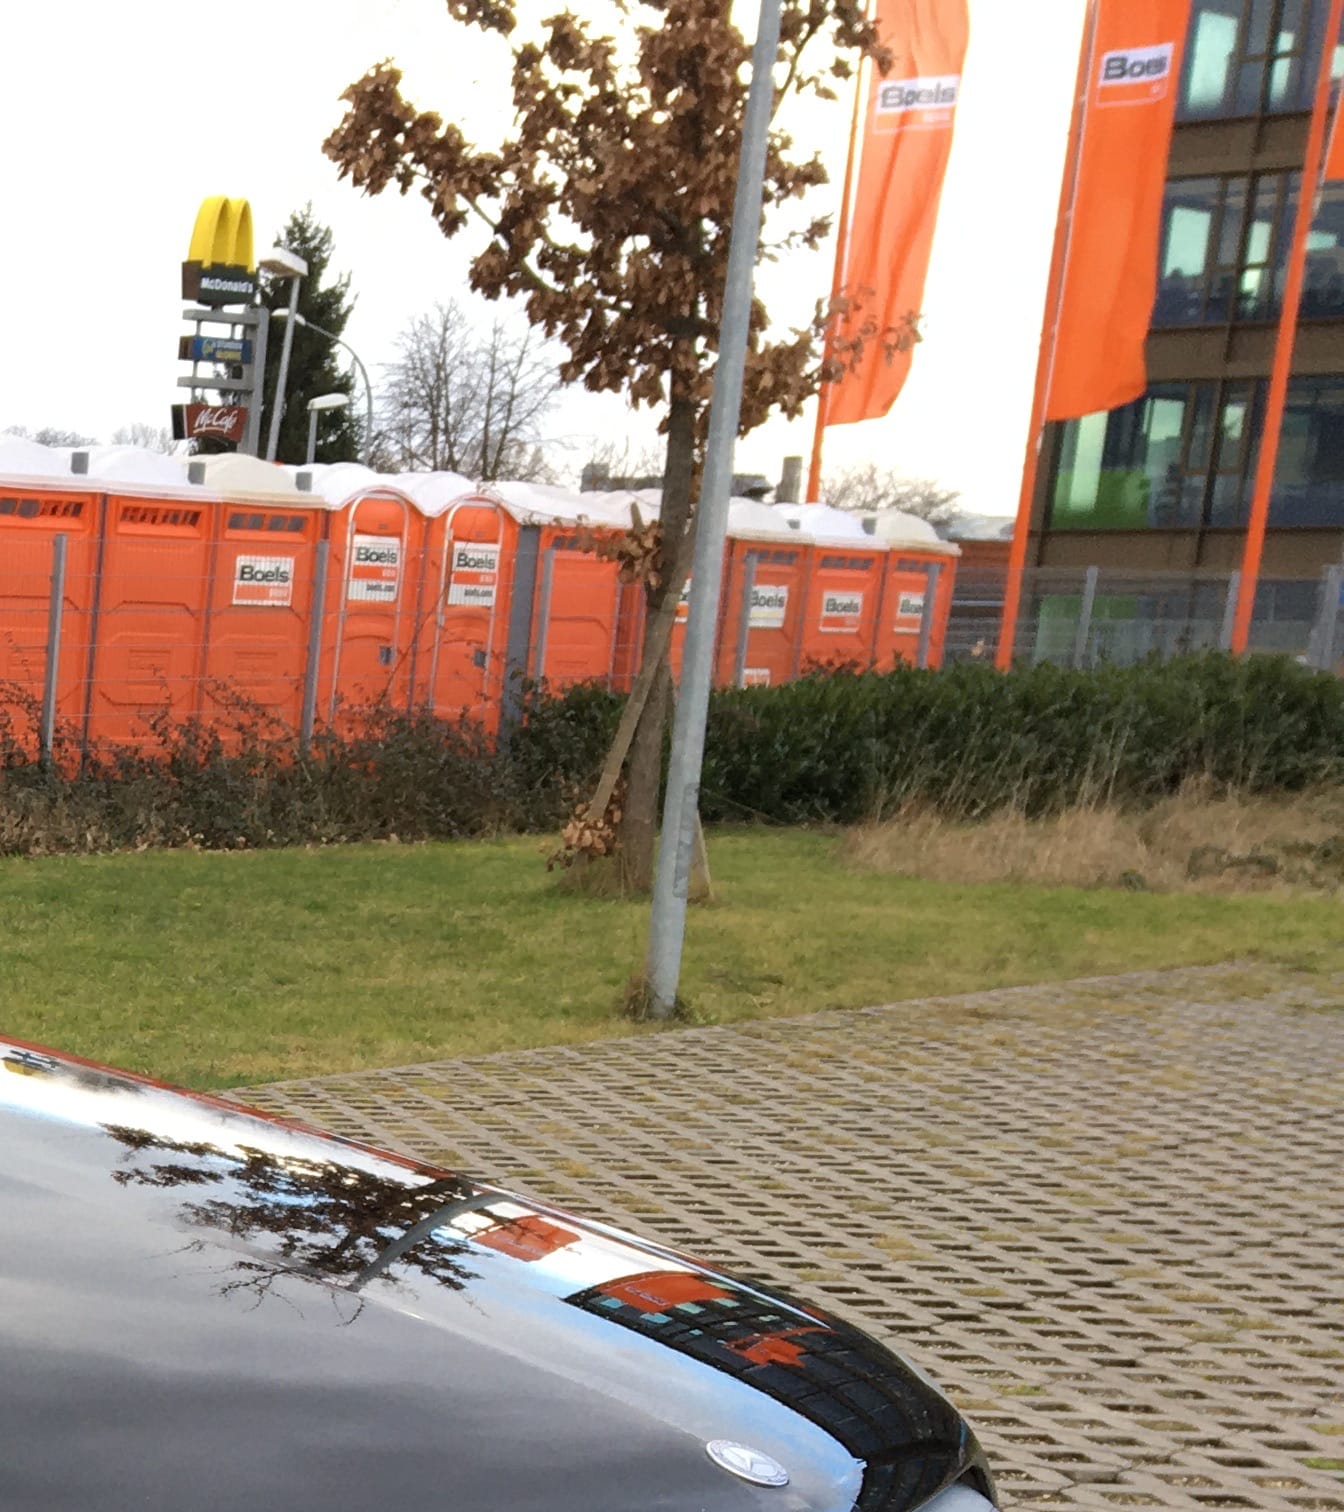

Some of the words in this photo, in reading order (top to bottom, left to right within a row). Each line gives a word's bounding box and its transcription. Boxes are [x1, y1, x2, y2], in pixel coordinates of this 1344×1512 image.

[881, 82, 955, 108] Boels
[356, 547, 398, 564] Boels
[456, 553, 496, 570] Boels
[239, 565, 290, 583] Boels
[825, 598, 860, 614] Boels
